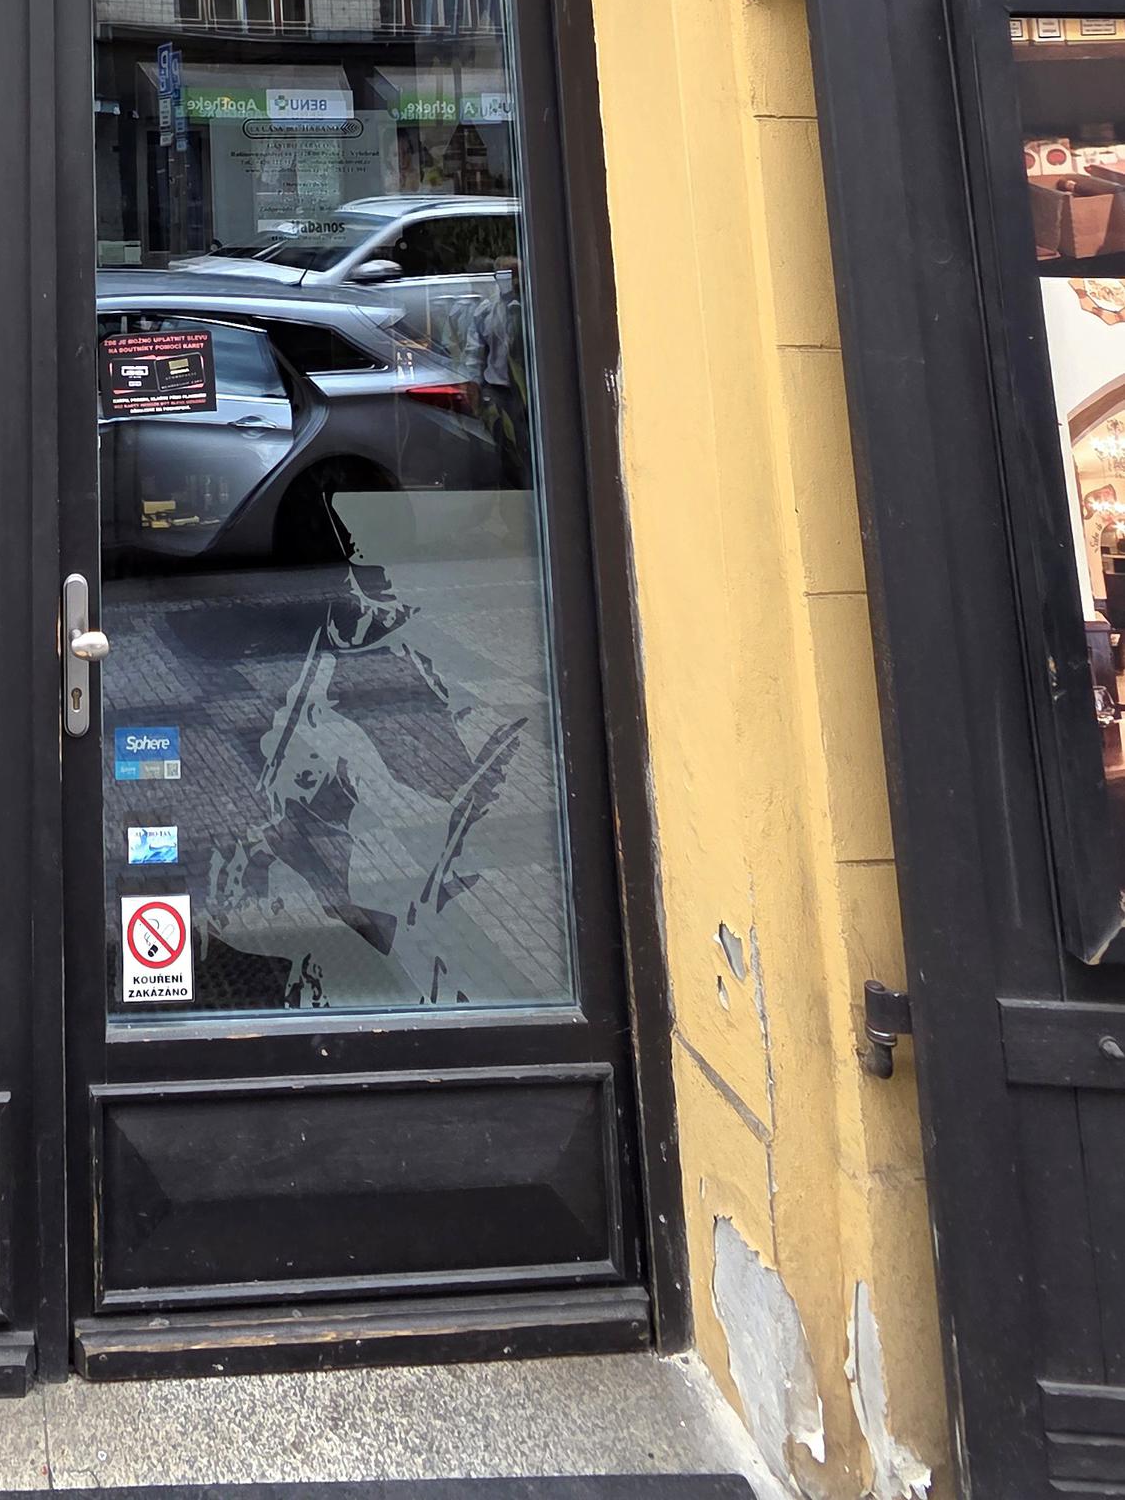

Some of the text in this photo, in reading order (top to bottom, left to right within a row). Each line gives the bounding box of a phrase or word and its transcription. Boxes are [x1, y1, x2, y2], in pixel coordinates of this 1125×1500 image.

[125, 735, 170, 753] Sphere
[133, 972, 183, 985] KOUŘENÍ
[128, 985, 188, 998] ZAKÁZÁNO
